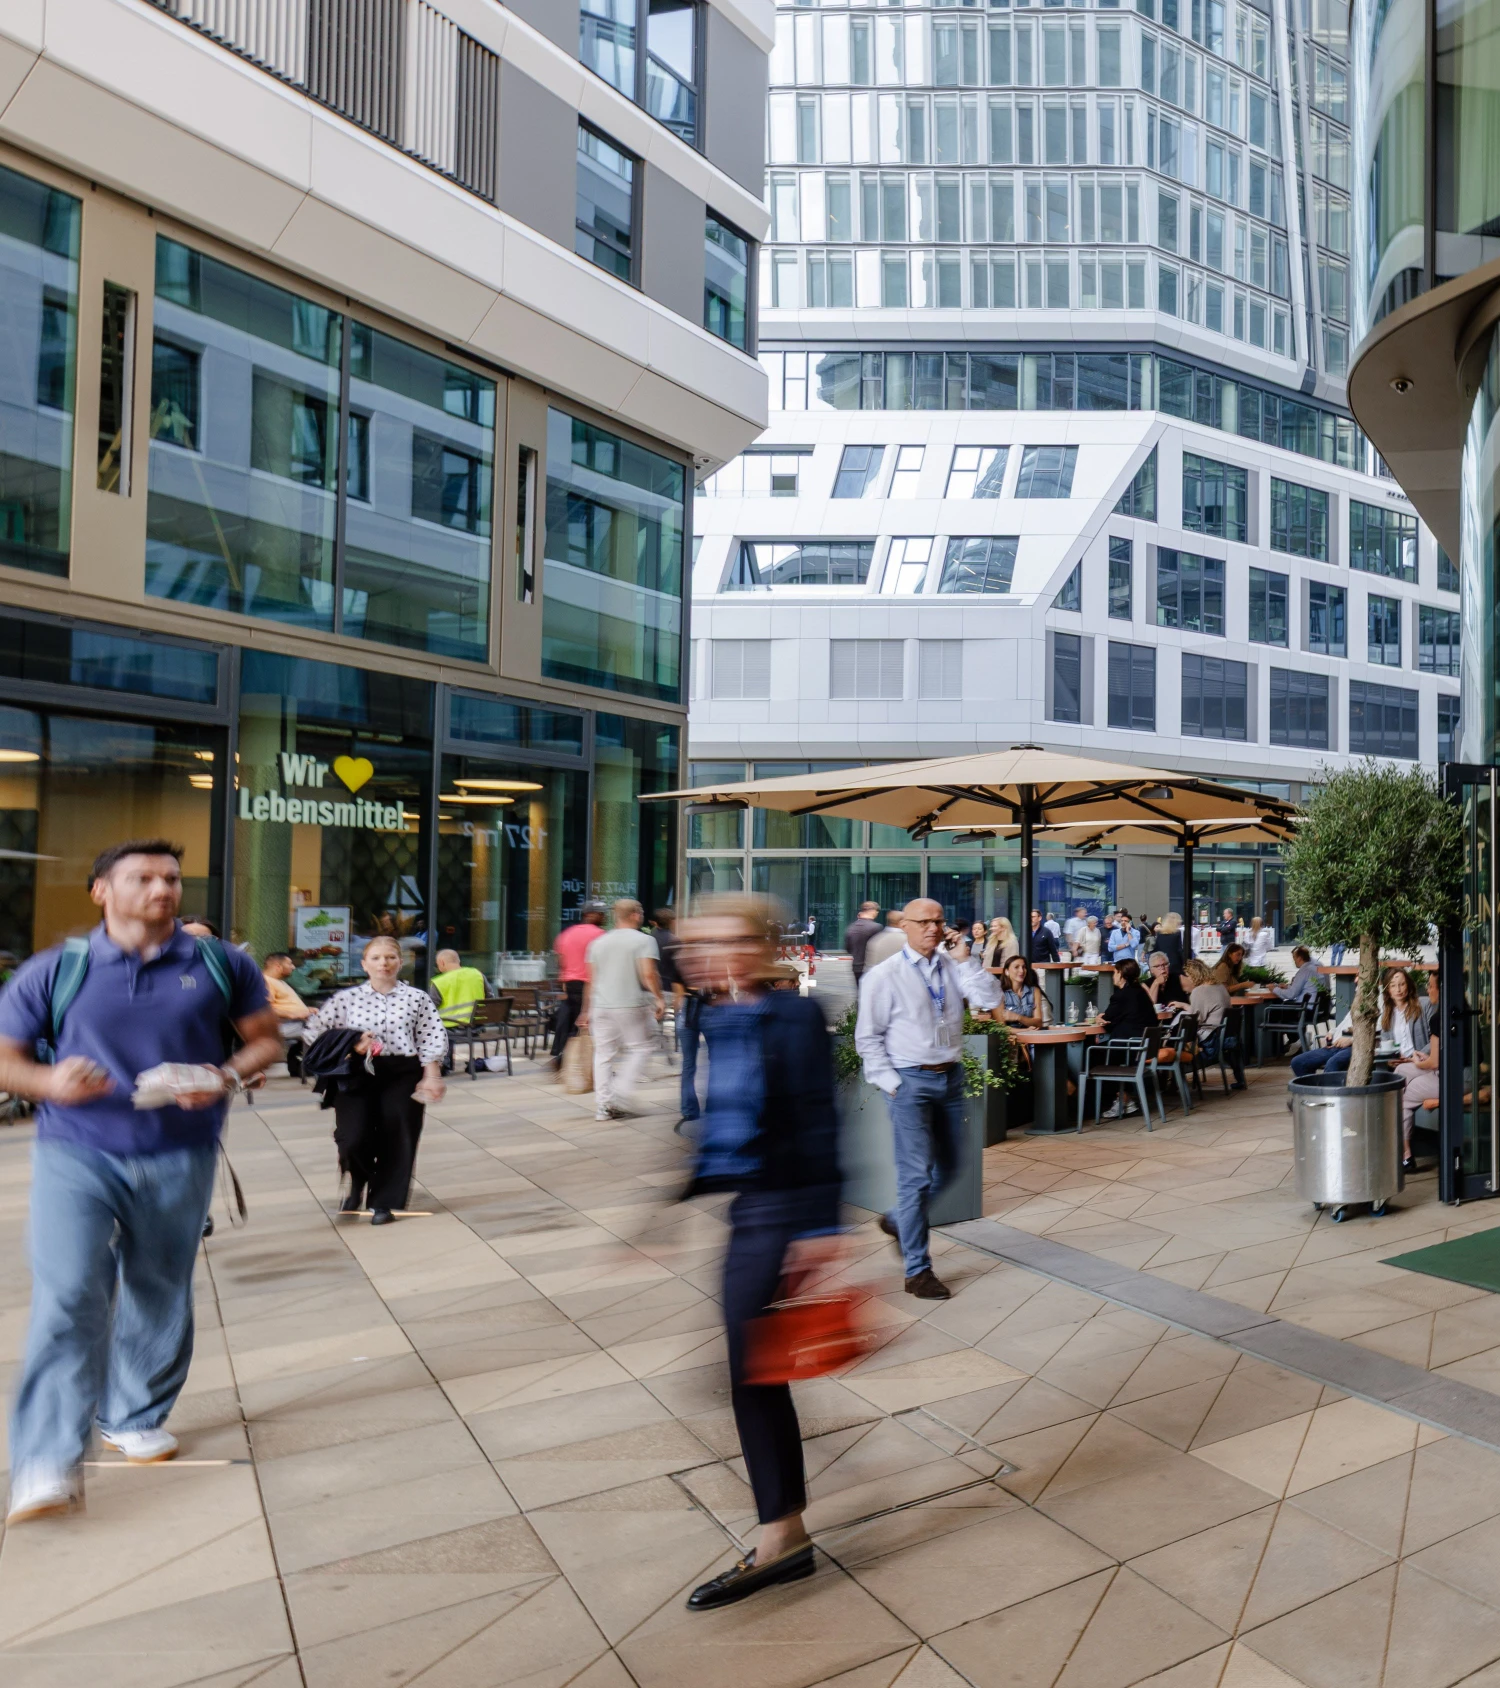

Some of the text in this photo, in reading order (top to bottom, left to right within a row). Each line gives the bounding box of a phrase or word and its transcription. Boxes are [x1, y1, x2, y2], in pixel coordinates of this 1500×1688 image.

[280, 751, 330, 788] Wir
[238, 786, 410, 832] Lebensmittel.
[1465, 842, 1486, 873] ET
